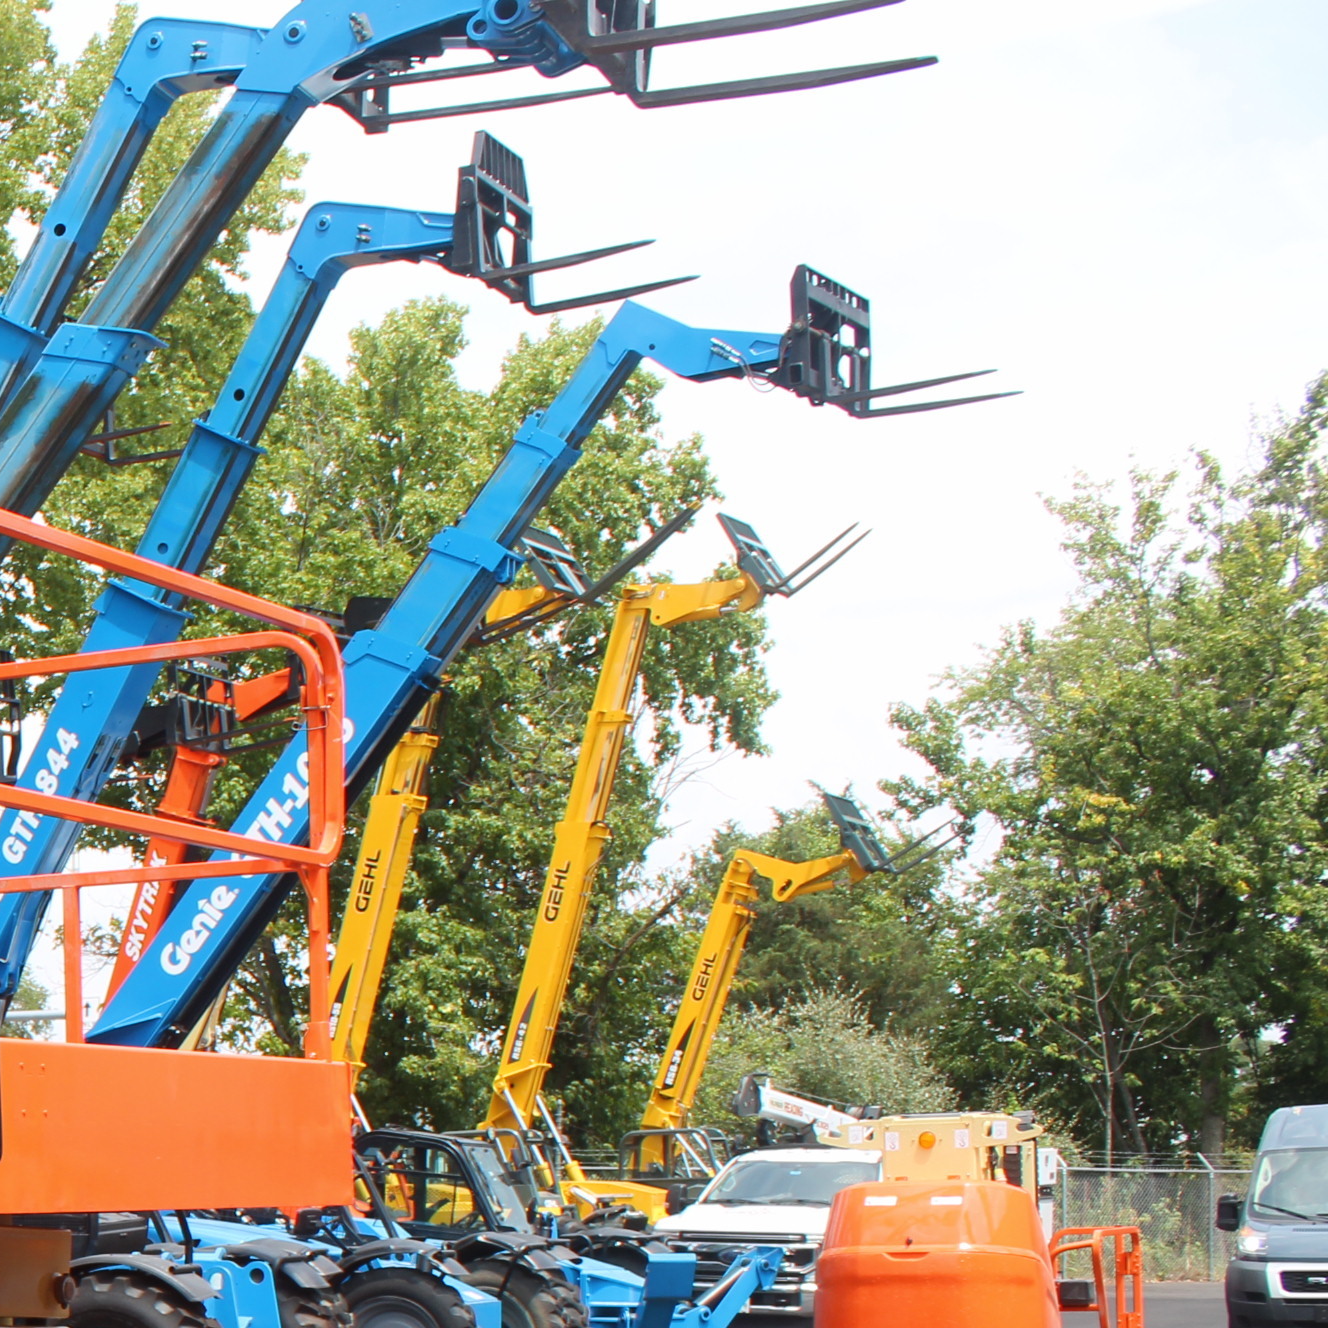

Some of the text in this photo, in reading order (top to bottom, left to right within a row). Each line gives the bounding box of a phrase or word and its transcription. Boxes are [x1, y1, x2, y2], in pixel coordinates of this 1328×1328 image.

[355, 849, 382, 913] GEHL
[543, 860, 572, 923] GEHL
[159, 884, 239, 976] Genie
[691, 952, 718, 1002] GEHL
